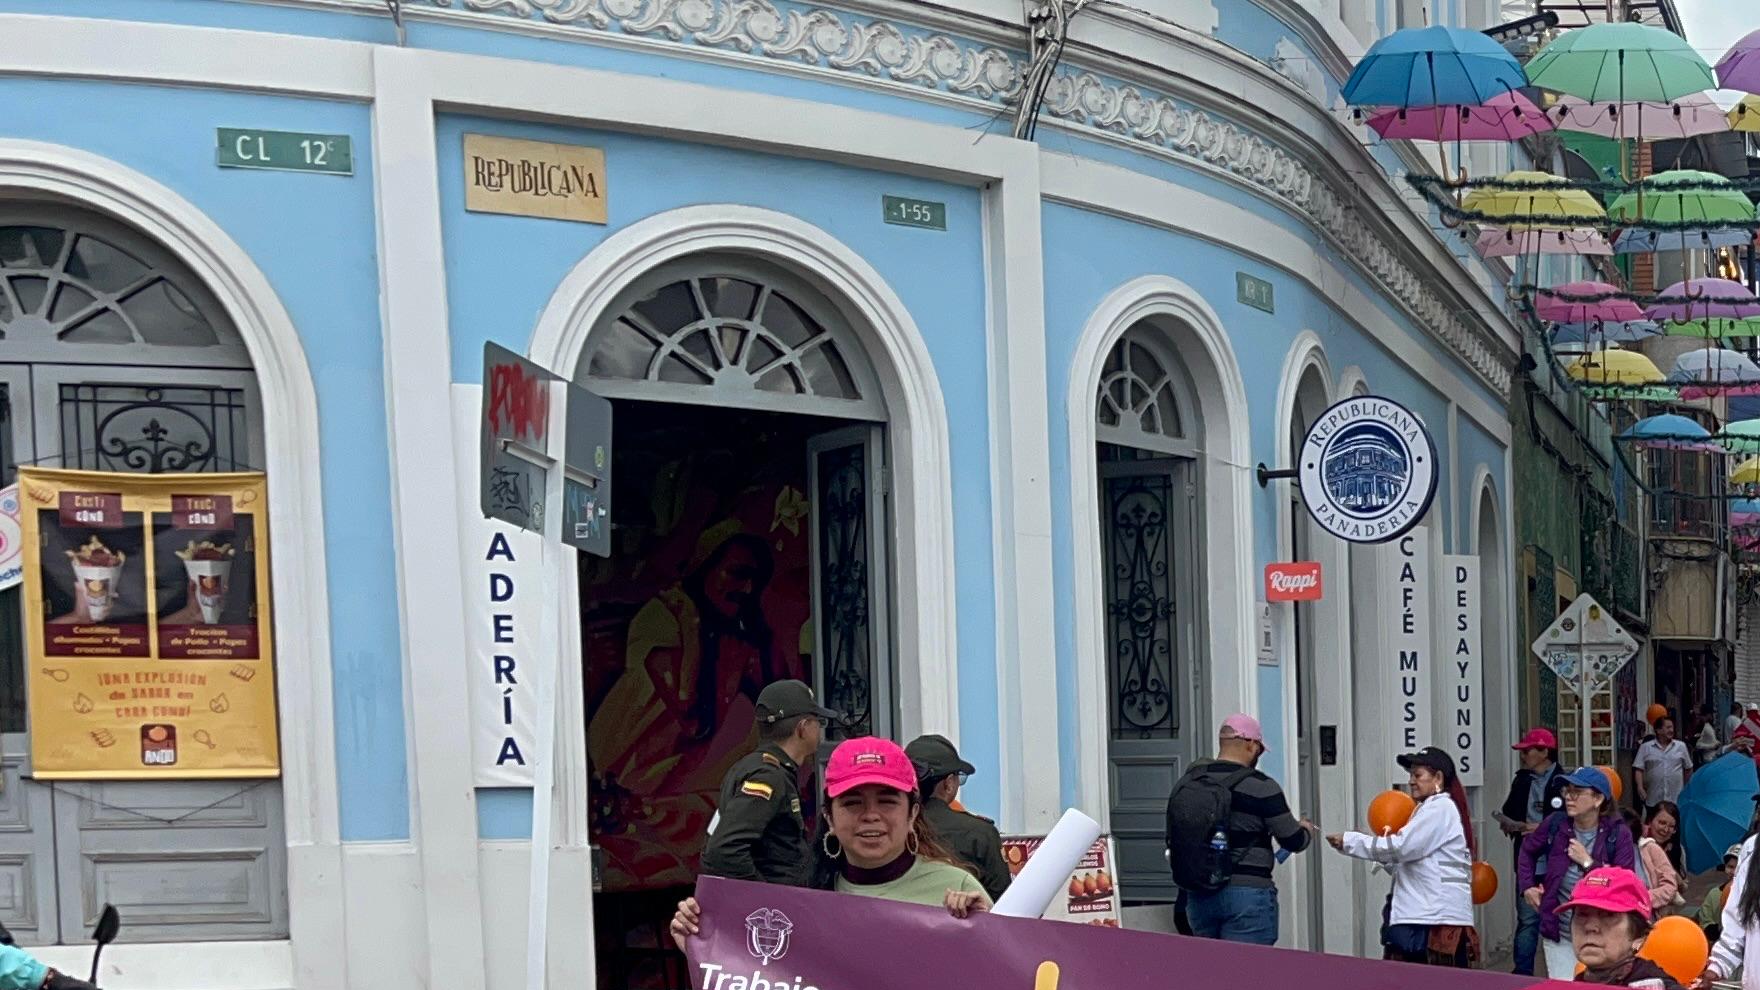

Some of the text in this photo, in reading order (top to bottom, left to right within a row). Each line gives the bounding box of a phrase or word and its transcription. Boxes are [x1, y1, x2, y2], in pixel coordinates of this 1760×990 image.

[236, 135, 271, 161] CL
[472, 155, 600, 199] REPUBLICANA
[899, 202, 931, 222] 1-55
[1308, 402, 1418, 448] REPUBLICANA
[1316, 500, 1419, 537] PANADERIA
[1269, 568, 1318, 593] Rappi
[485, 531, 527, 767] ADERÍA
[1399, 536, 1419, 748] CAFÉ MUSE
[1455, 565, 1472, 774] DESAYUNOS
